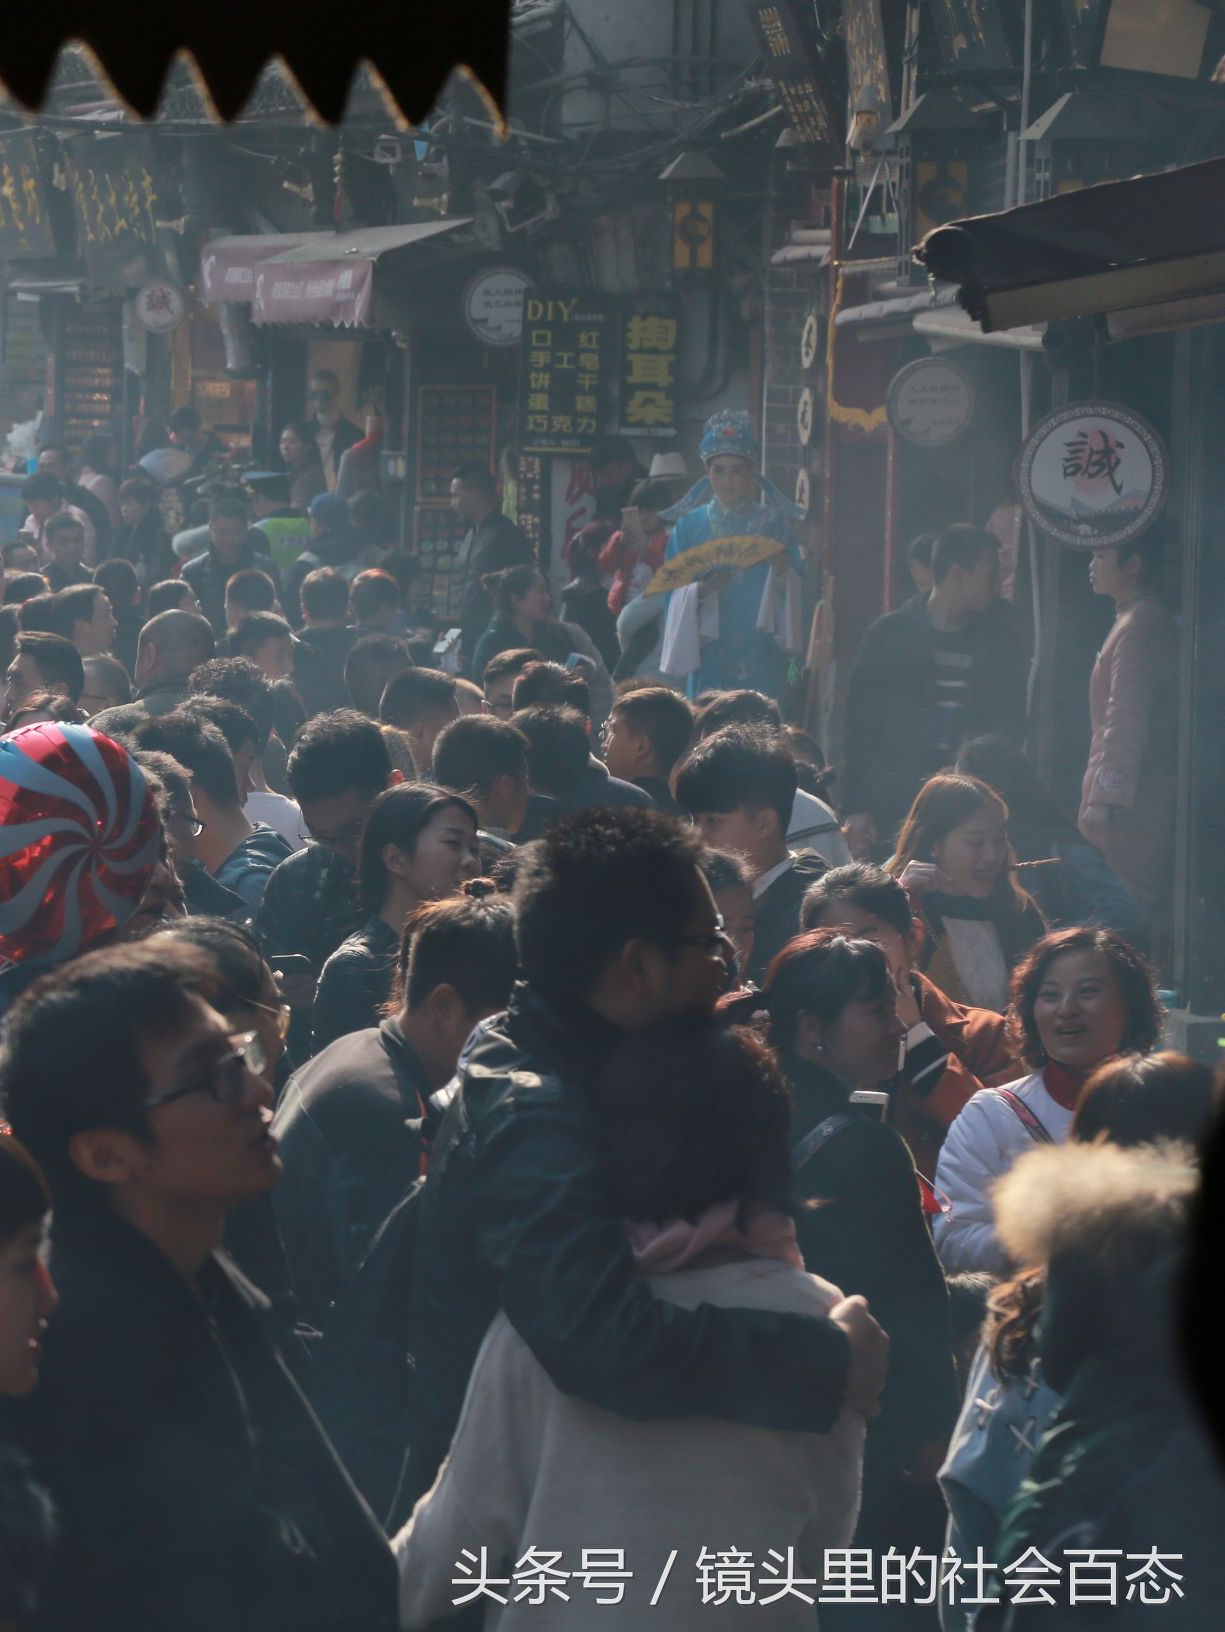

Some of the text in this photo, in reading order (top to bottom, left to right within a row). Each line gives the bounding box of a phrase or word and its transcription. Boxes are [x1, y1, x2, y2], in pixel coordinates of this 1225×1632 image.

[527, 297, 579, 321] DIY
[531, 329, 600, 350] 口红
[529, 351, 600, 371] 手工皂
[626, 314, 678, 424] 掏耳朵
[528, 372, 600, 391] 饼干
[527, 393, 598, 413] 蛋糕
[527, 415, 598, 434] 巧克力
[1062, 429, 1125, 496] 誠
